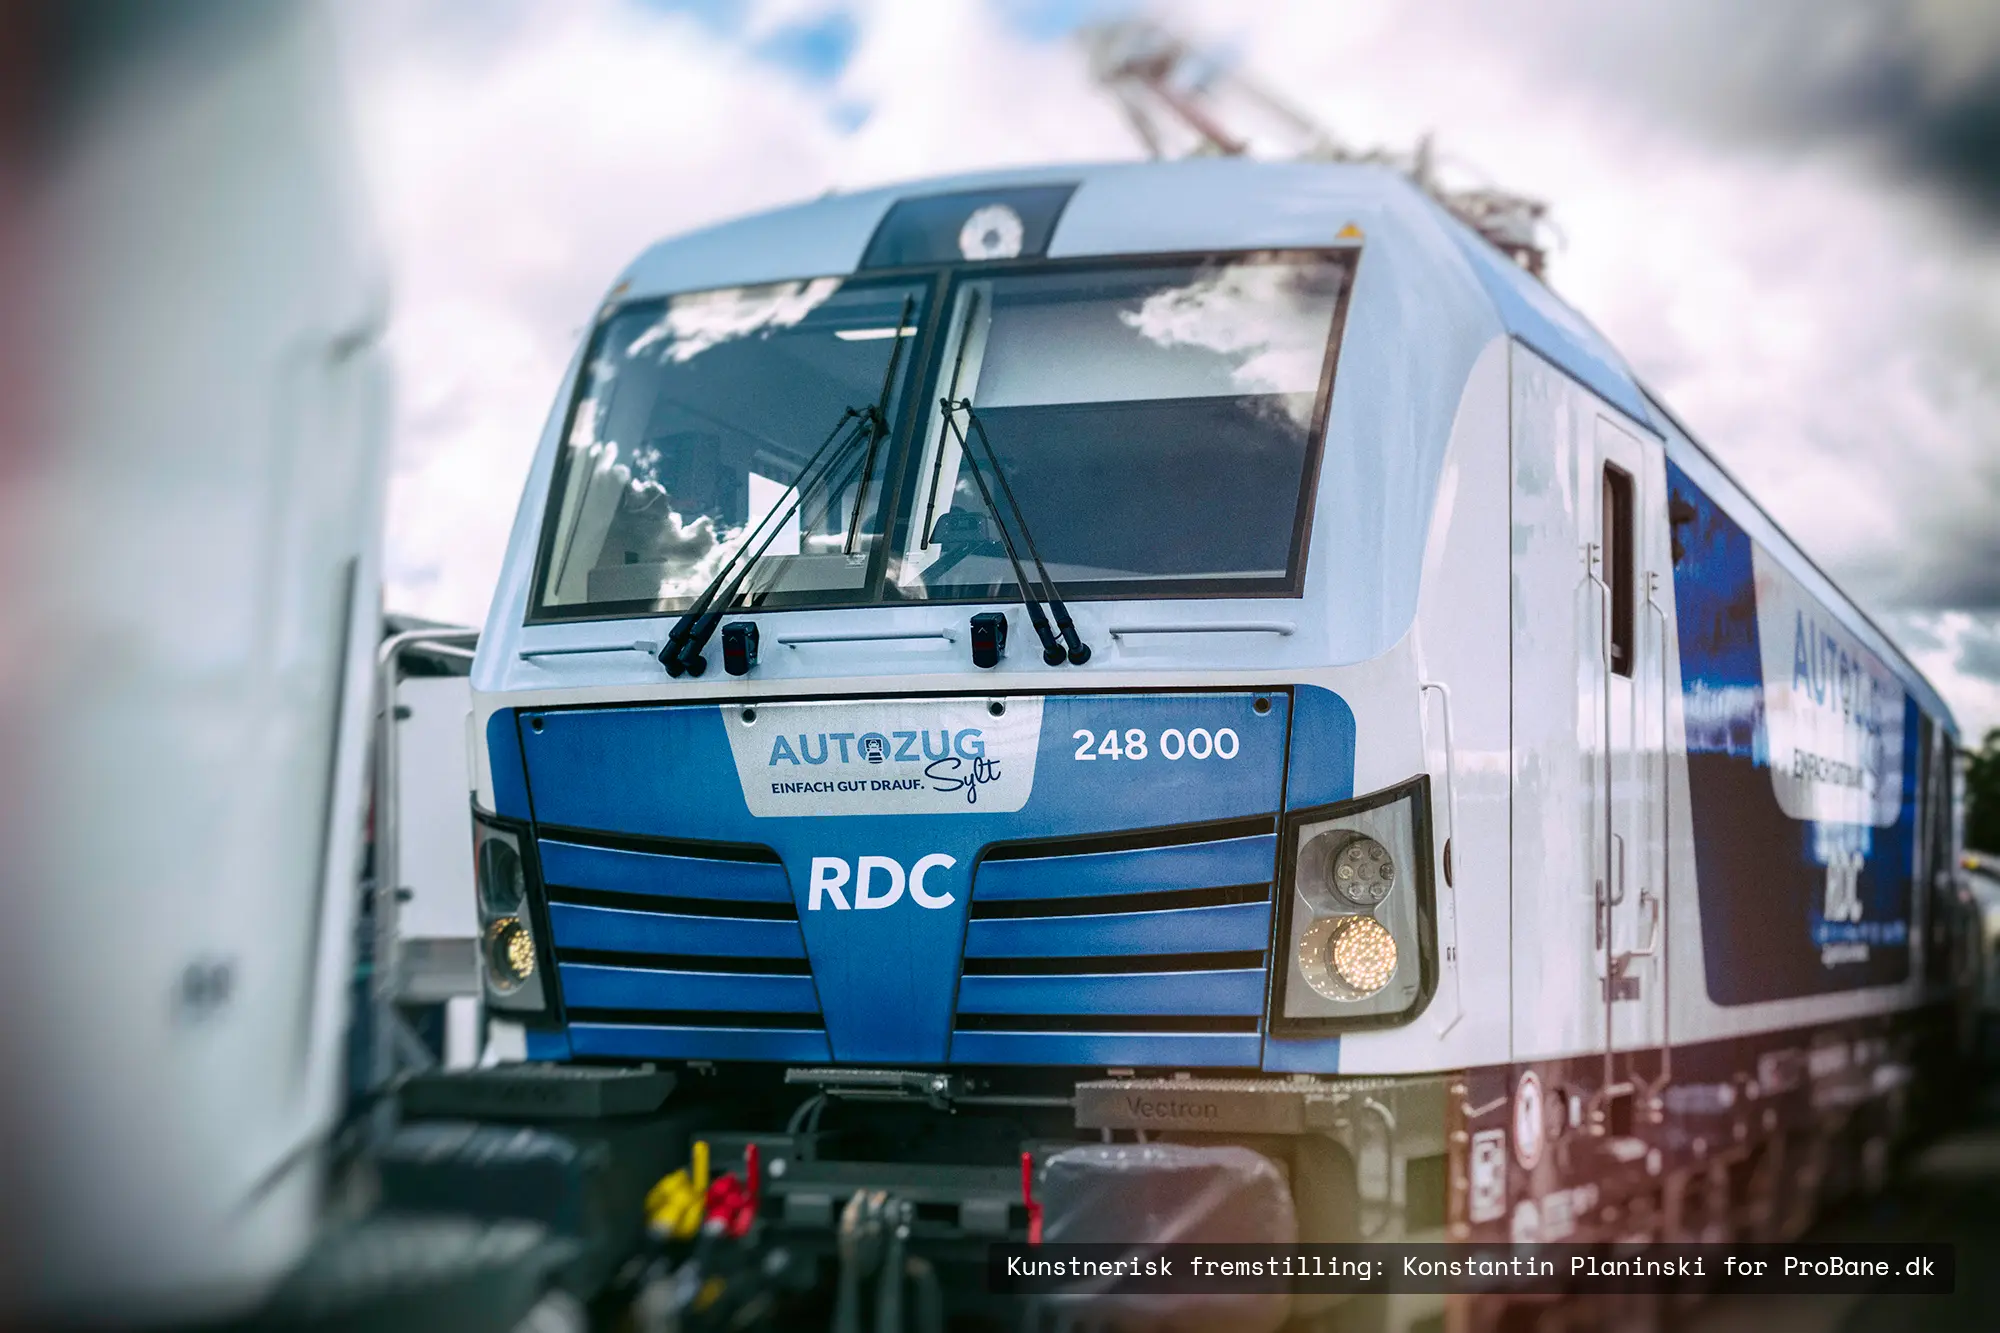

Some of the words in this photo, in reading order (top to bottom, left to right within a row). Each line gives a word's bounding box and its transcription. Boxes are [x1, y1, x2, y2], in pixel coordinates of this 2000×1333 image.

[768, 728, 986, 766] AUTOZUG
[1073, 728, 1148, 761] 248
[1160, 727, 1239, 761] 000
[771, 781, 835, 794] EINFACH
[837, 780, 868, 793] GUT
[871, 779, 926, 791] DRAUF.
[924, 756, 1001, 804] Sylt
[808, 853, 956, 911] RDC
[1126, 1096, 1220, 1118] Vectron
